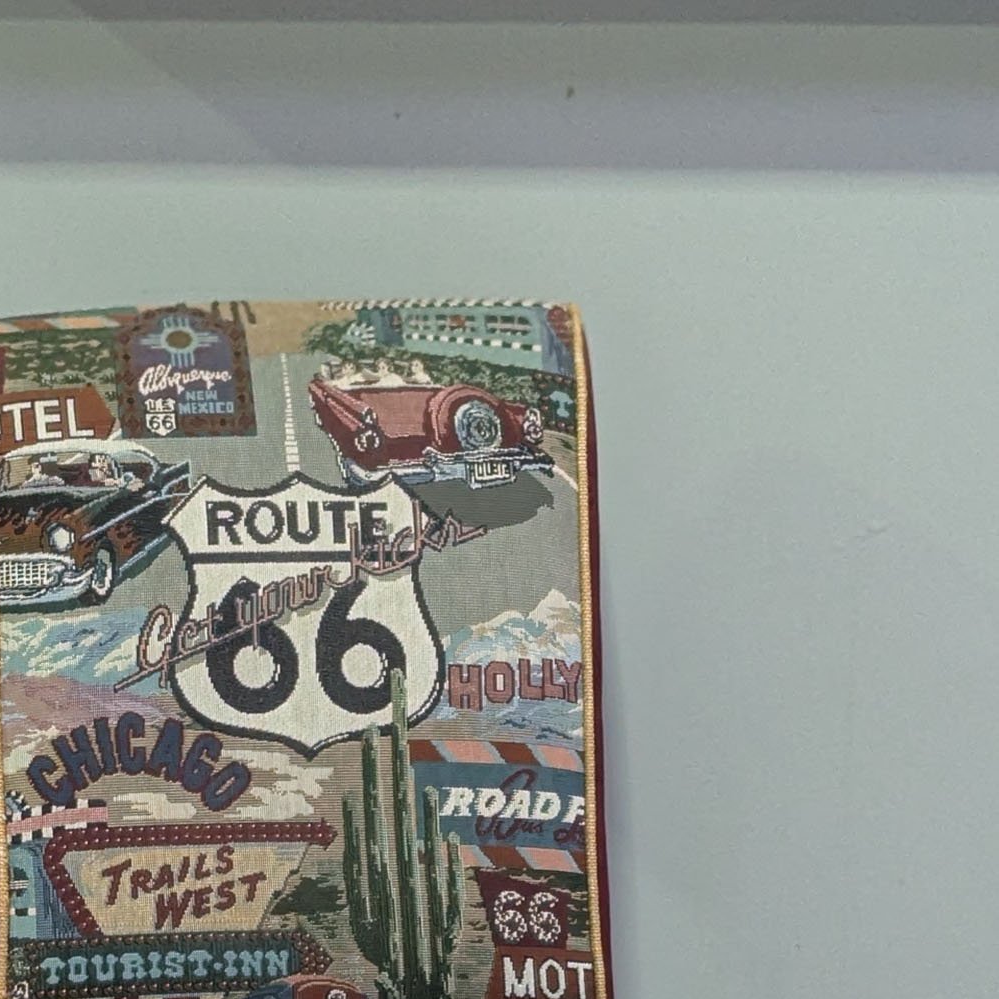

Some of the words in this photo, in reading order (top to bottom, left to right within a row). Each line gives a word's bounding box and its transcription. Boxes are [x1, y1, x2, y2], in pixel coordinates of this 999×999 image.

[178, 400, 235, 415] MEXICO
[185, 389, 218, 401] NEW
[148, 414, 173, 431] 66
[205, 499, 389, 547] ROUTE
[138, 604, 224, 688] Get
[206, 575, 407, 715] 66
[448, 657, 583, 712] HOLLY
[26, 710, 251, 812] CHICAGO
[438, 786, 563, 821] ROAD
[101, 844, 235, 905] TRAILS
[155, 870, 267, 930] WEST
[493, 889, 562, 943] 66
